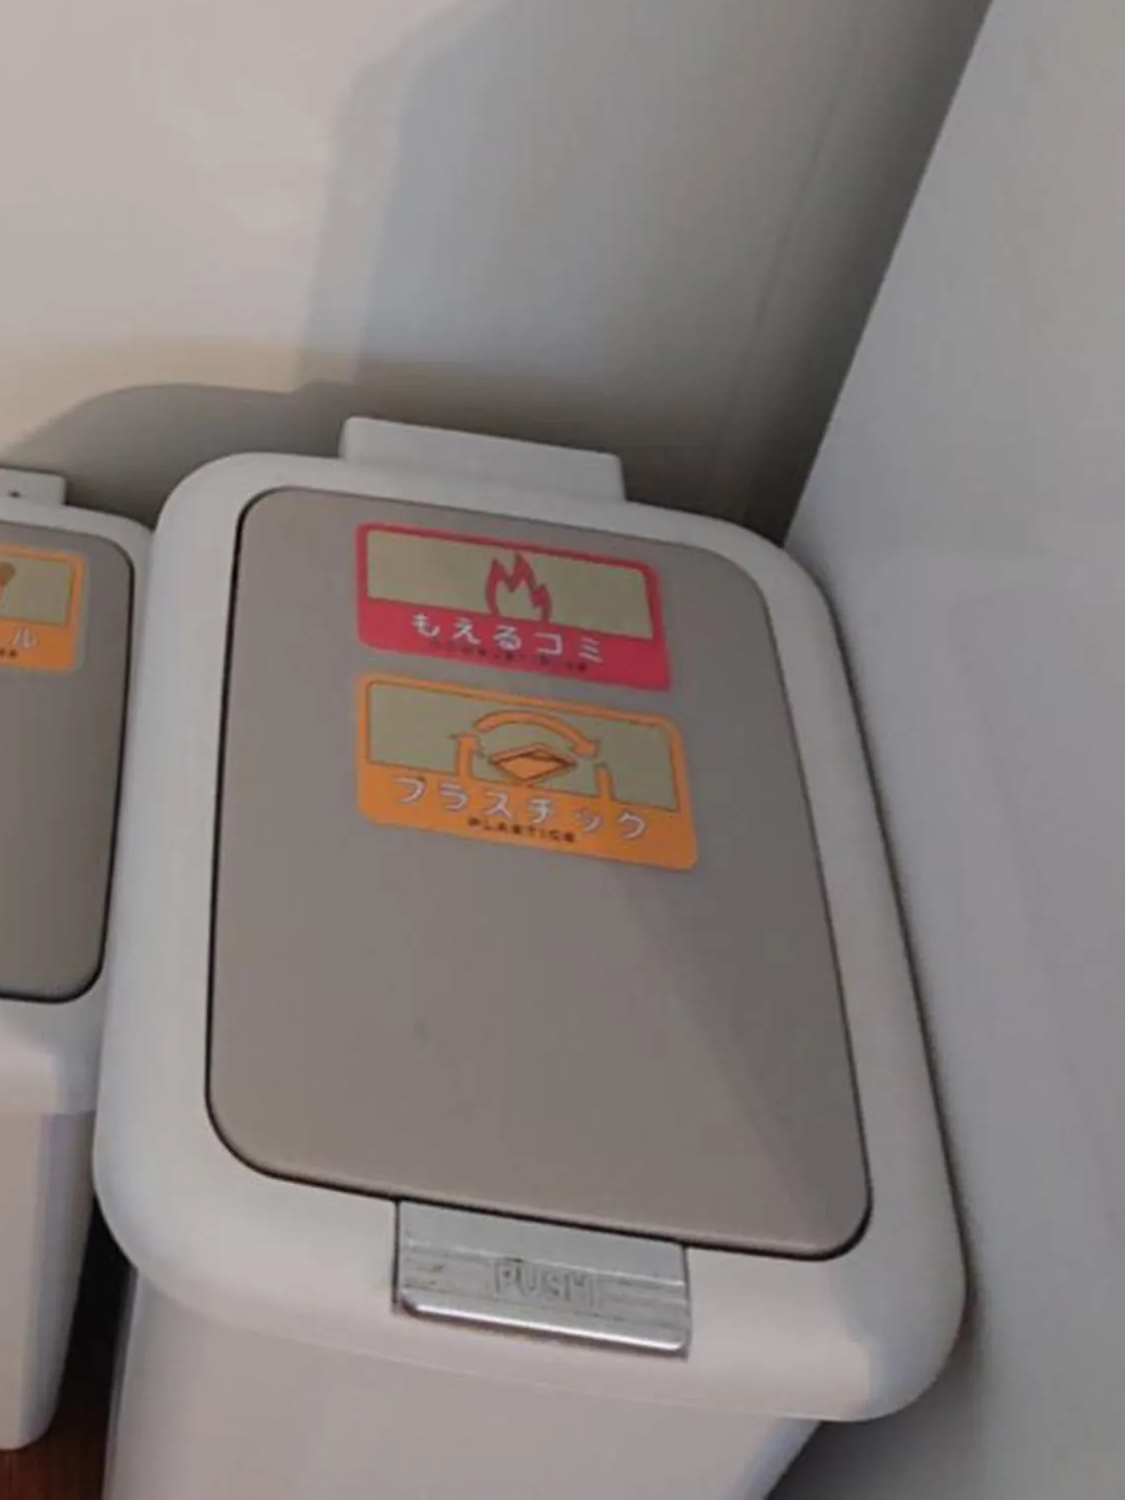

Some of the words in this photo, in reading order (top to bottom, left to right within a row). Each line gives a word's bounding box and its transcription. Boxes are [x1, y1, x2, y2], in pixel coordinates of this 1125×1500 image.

[394, 774, 647, 840] プラスチック
